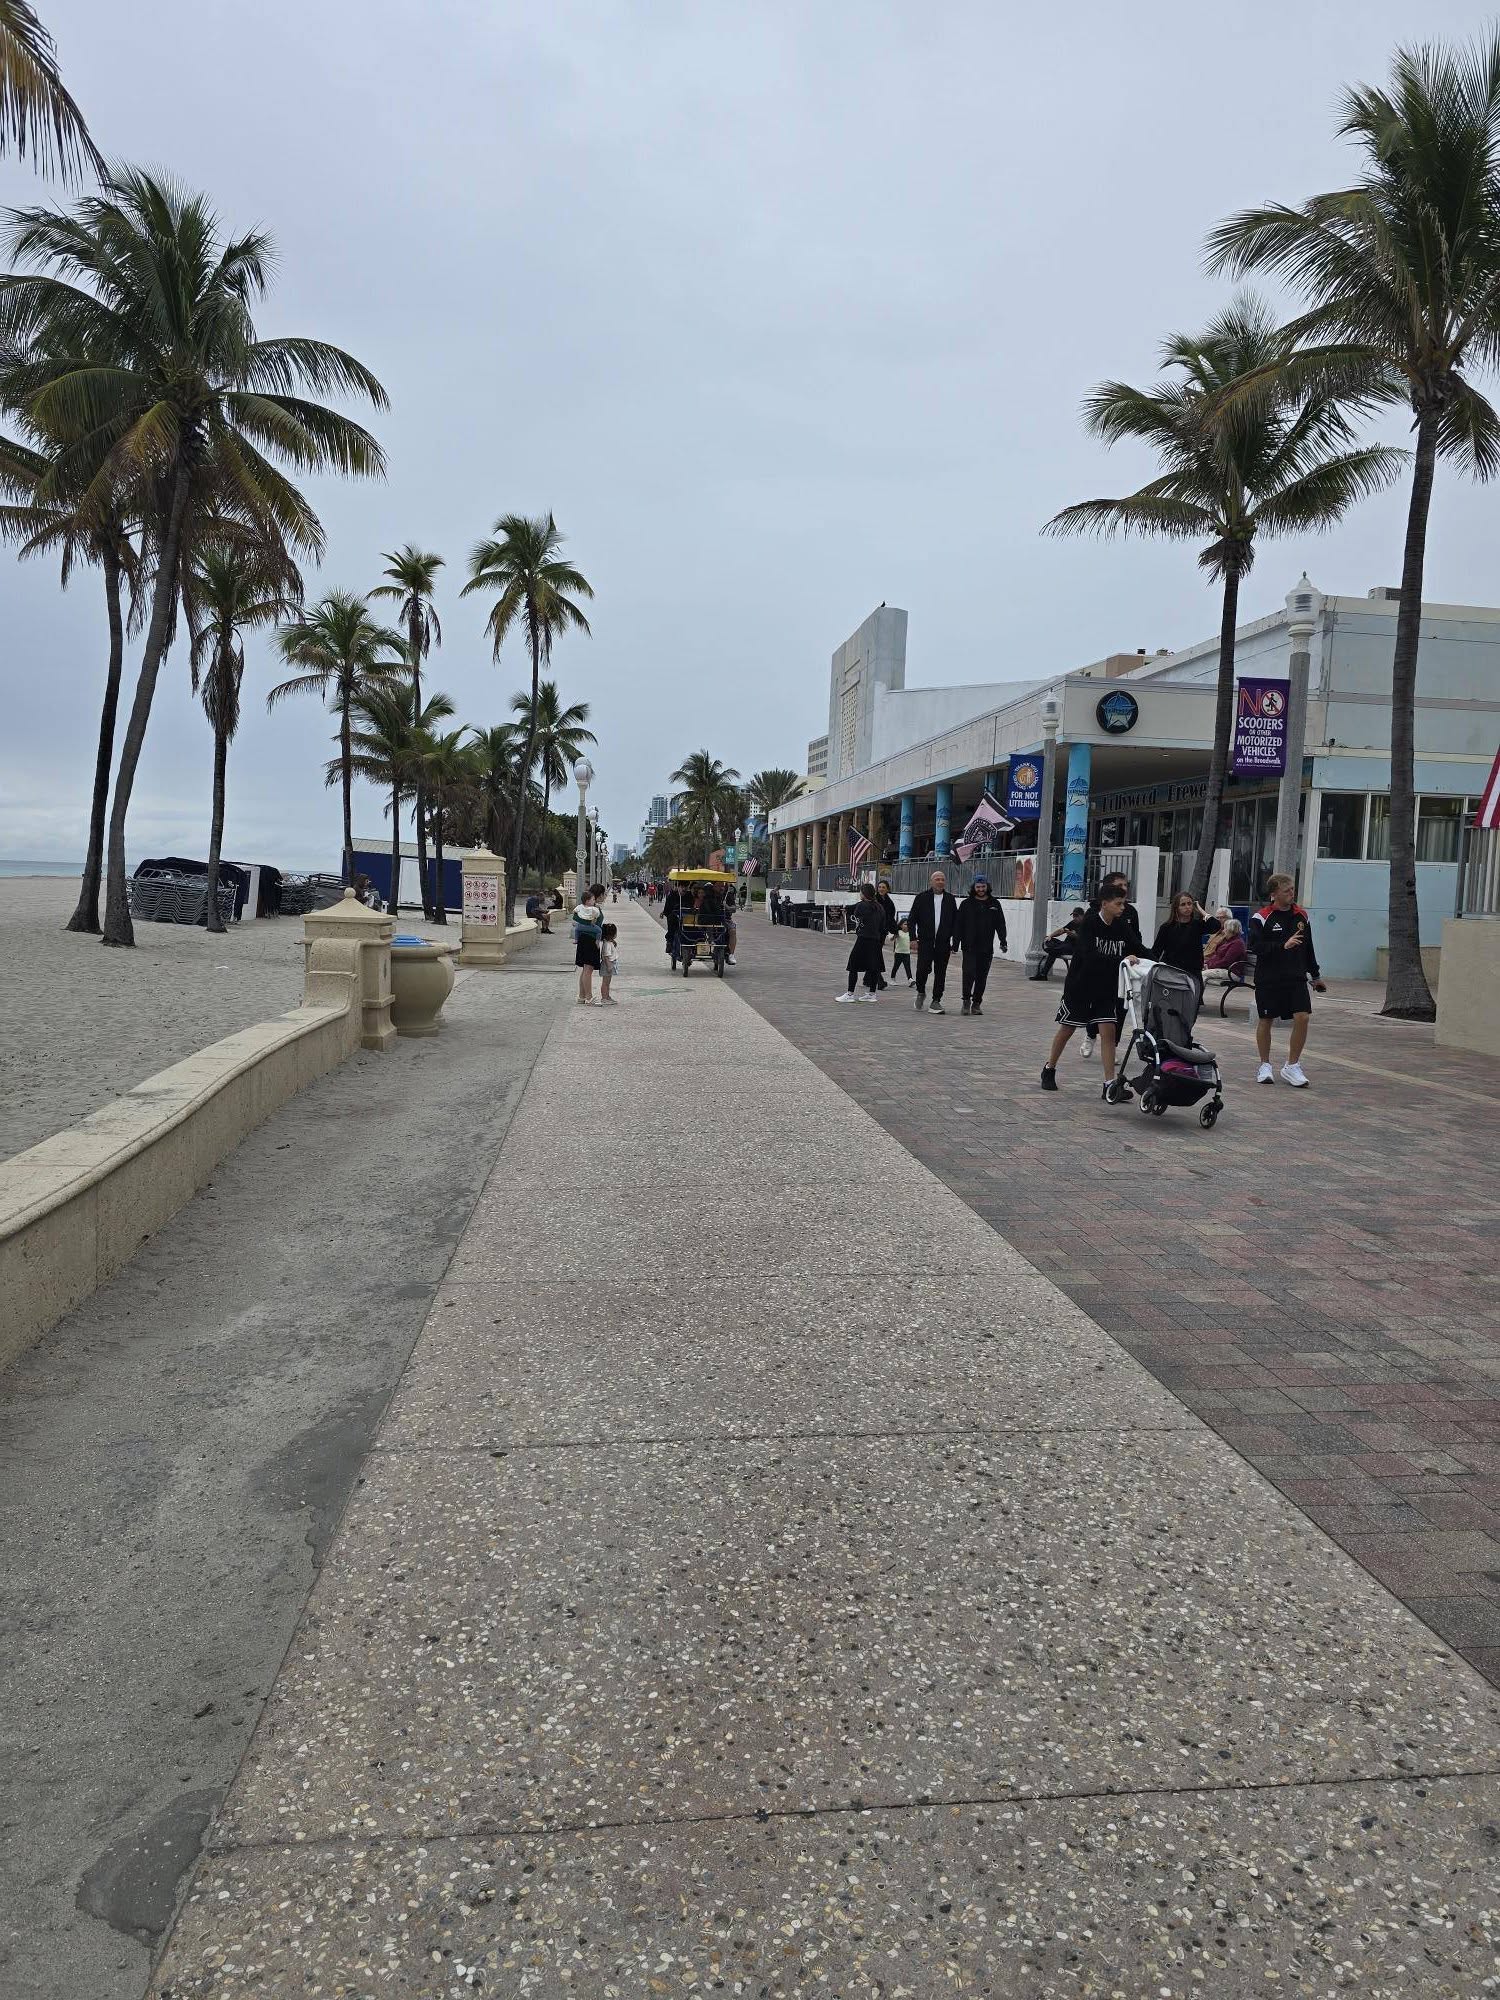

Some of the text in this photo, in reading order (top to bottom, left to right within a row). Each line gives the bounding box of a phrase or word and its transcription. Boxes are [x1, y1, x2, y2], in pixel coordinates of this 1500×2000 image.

[1238, 717, 1283, 730] SCOOTERS
[1237, 735, 1282, 747] MOTORIZED
[1242, 746, 1277, 757] VEHICLES
[1244, 756, 1253, 764] the
[1011, 791, 1039, 800] FOR NOT
[1009, 799, 1039, 808] LITTERING
